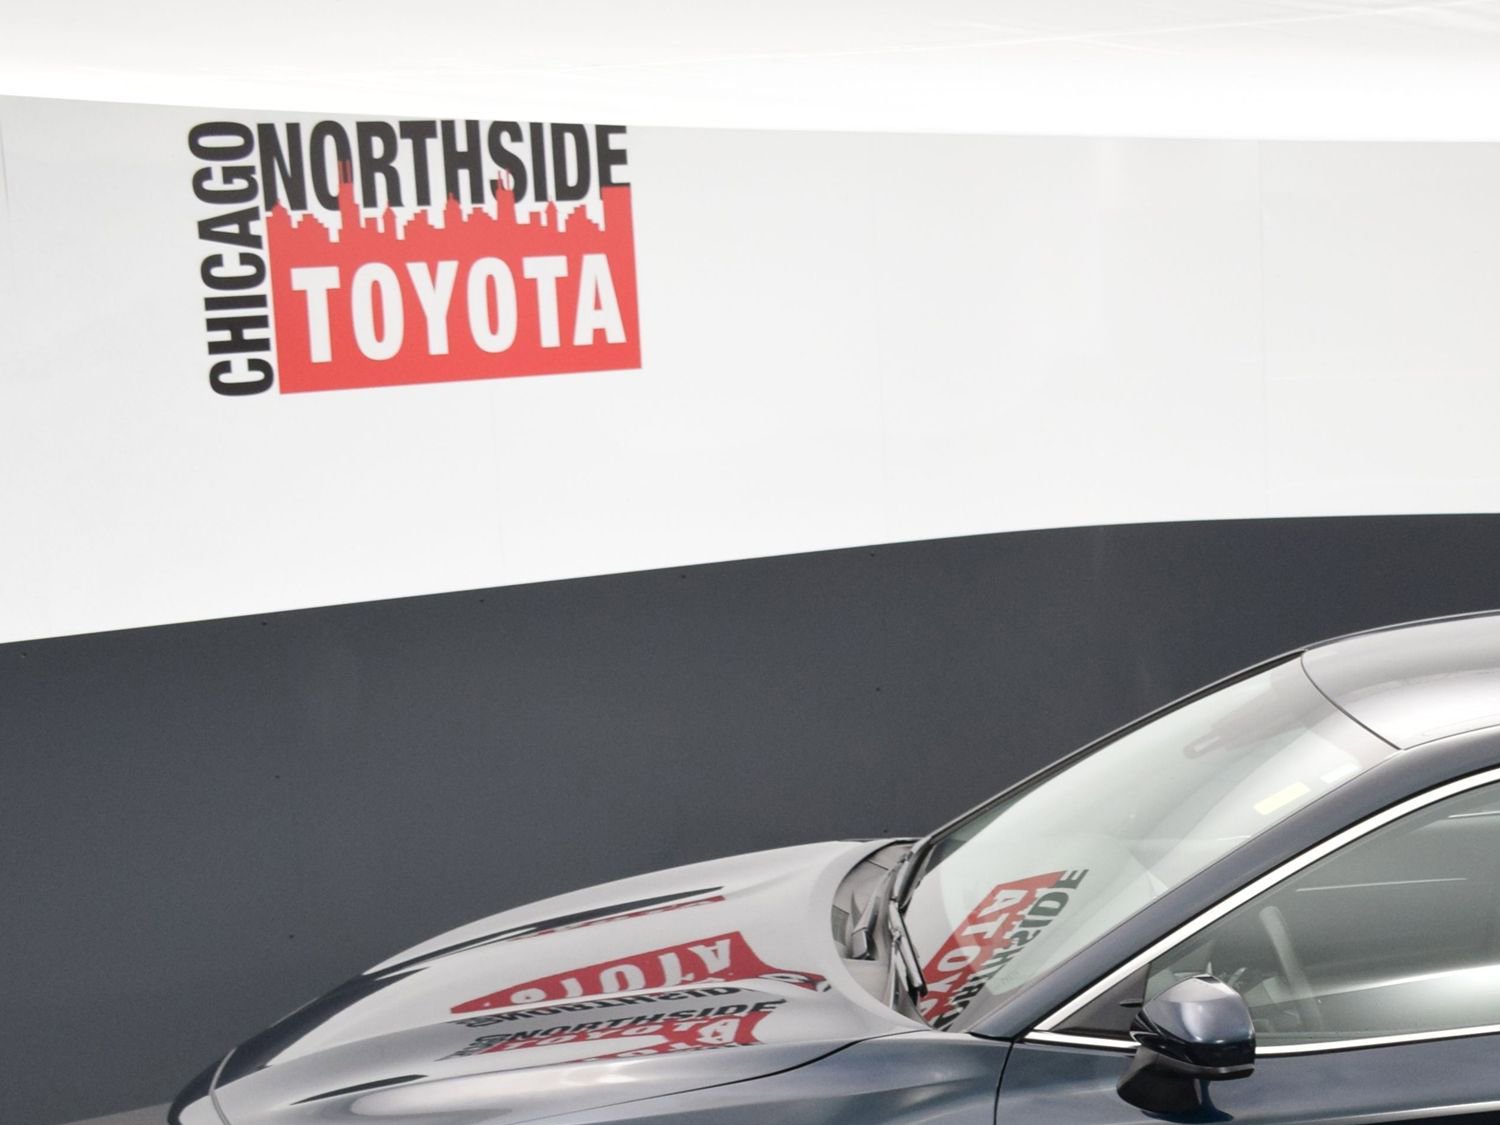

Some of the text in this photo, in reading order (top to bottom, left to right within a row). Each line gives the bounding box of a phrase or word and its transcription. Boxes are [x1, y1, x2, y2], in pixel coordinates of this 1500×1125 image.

[256, 119, 631, 213] NORTHSIDE
[188, 121, 274, 396] CHICAGO
[290, 253, 627, 364] TOYOTA
